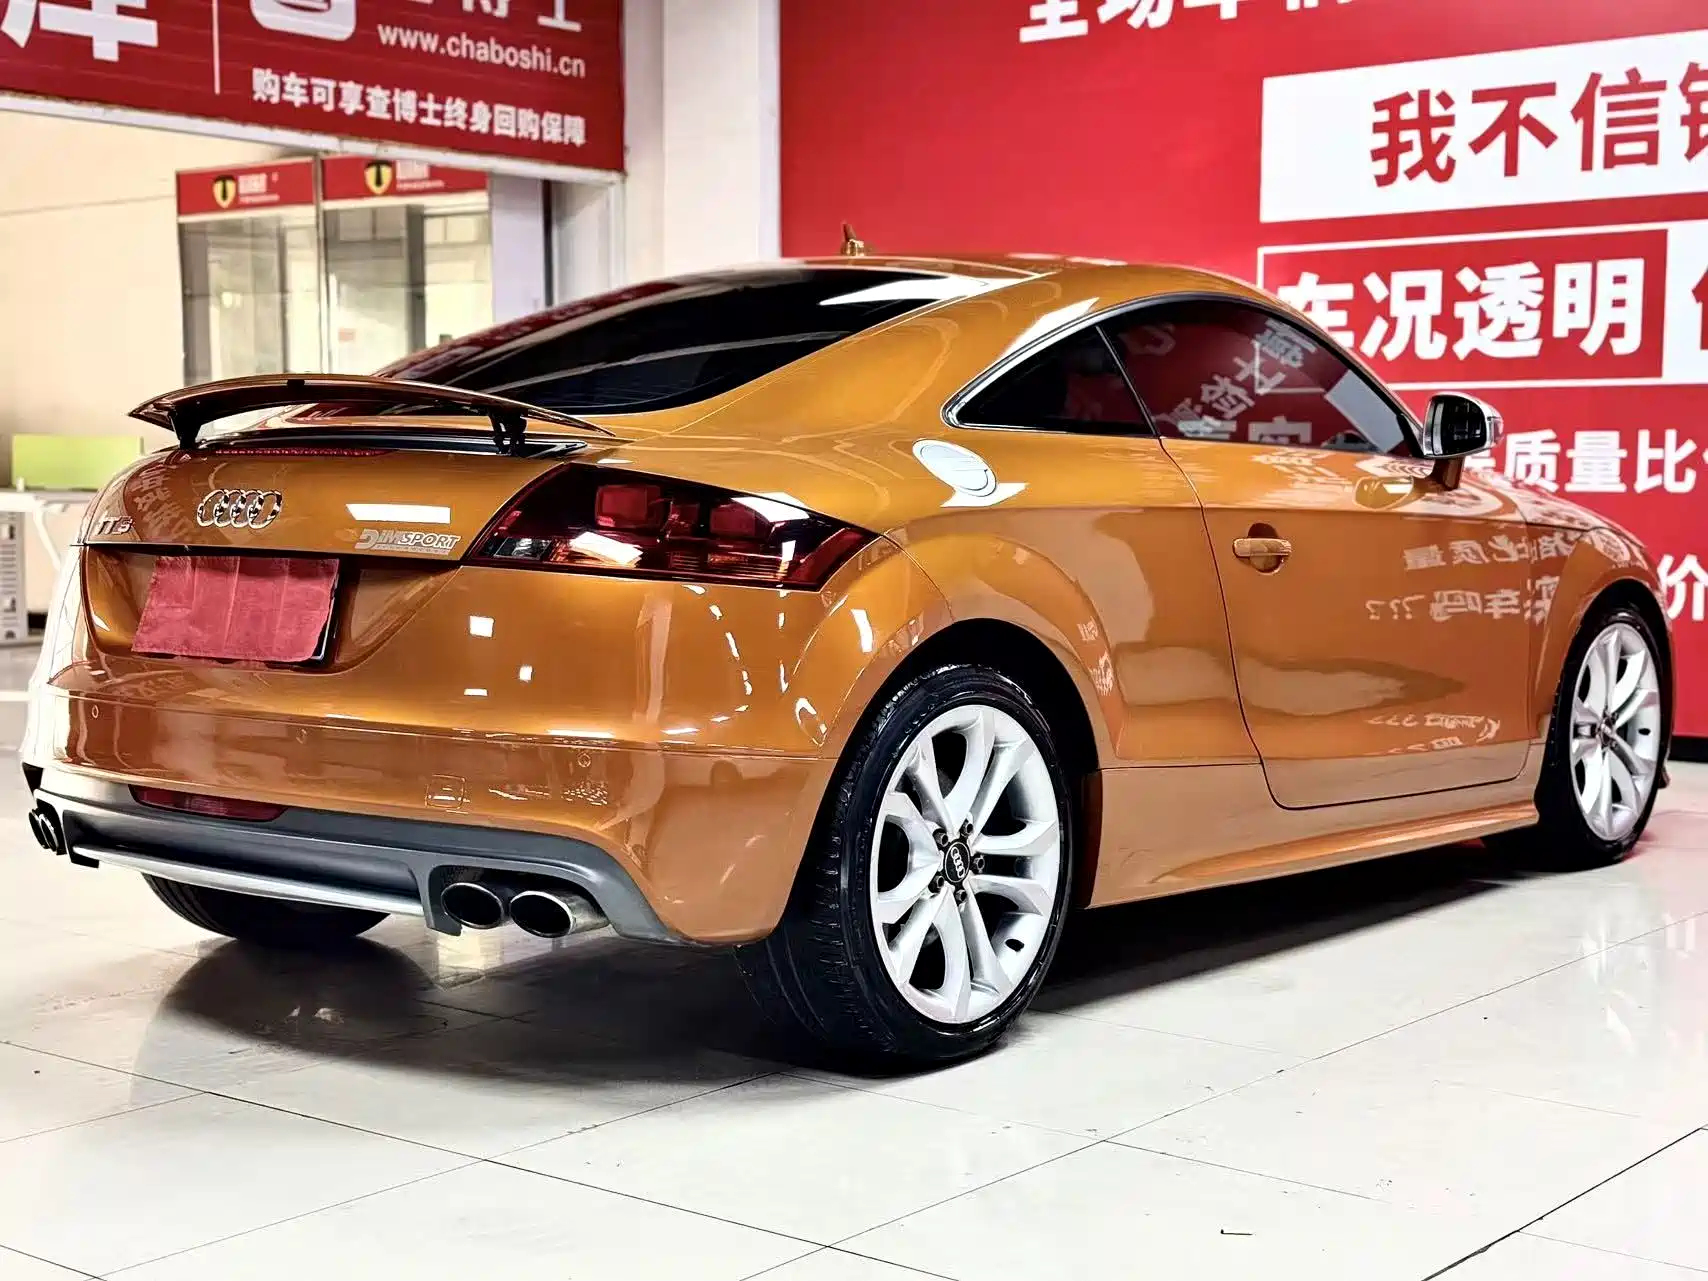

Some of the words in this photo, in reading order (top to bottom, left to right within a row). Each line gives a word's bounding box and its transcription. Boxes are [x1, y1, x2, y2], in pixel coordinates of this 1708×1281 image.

[377, 24, 586, 78] www.chaboshi.cn
[251, 67, 586, 147] 购车可享查博士终身回购保障
[1277, 257, 1645, 361] 车况透明
[1464, 428, 1708, 494] 质量比
